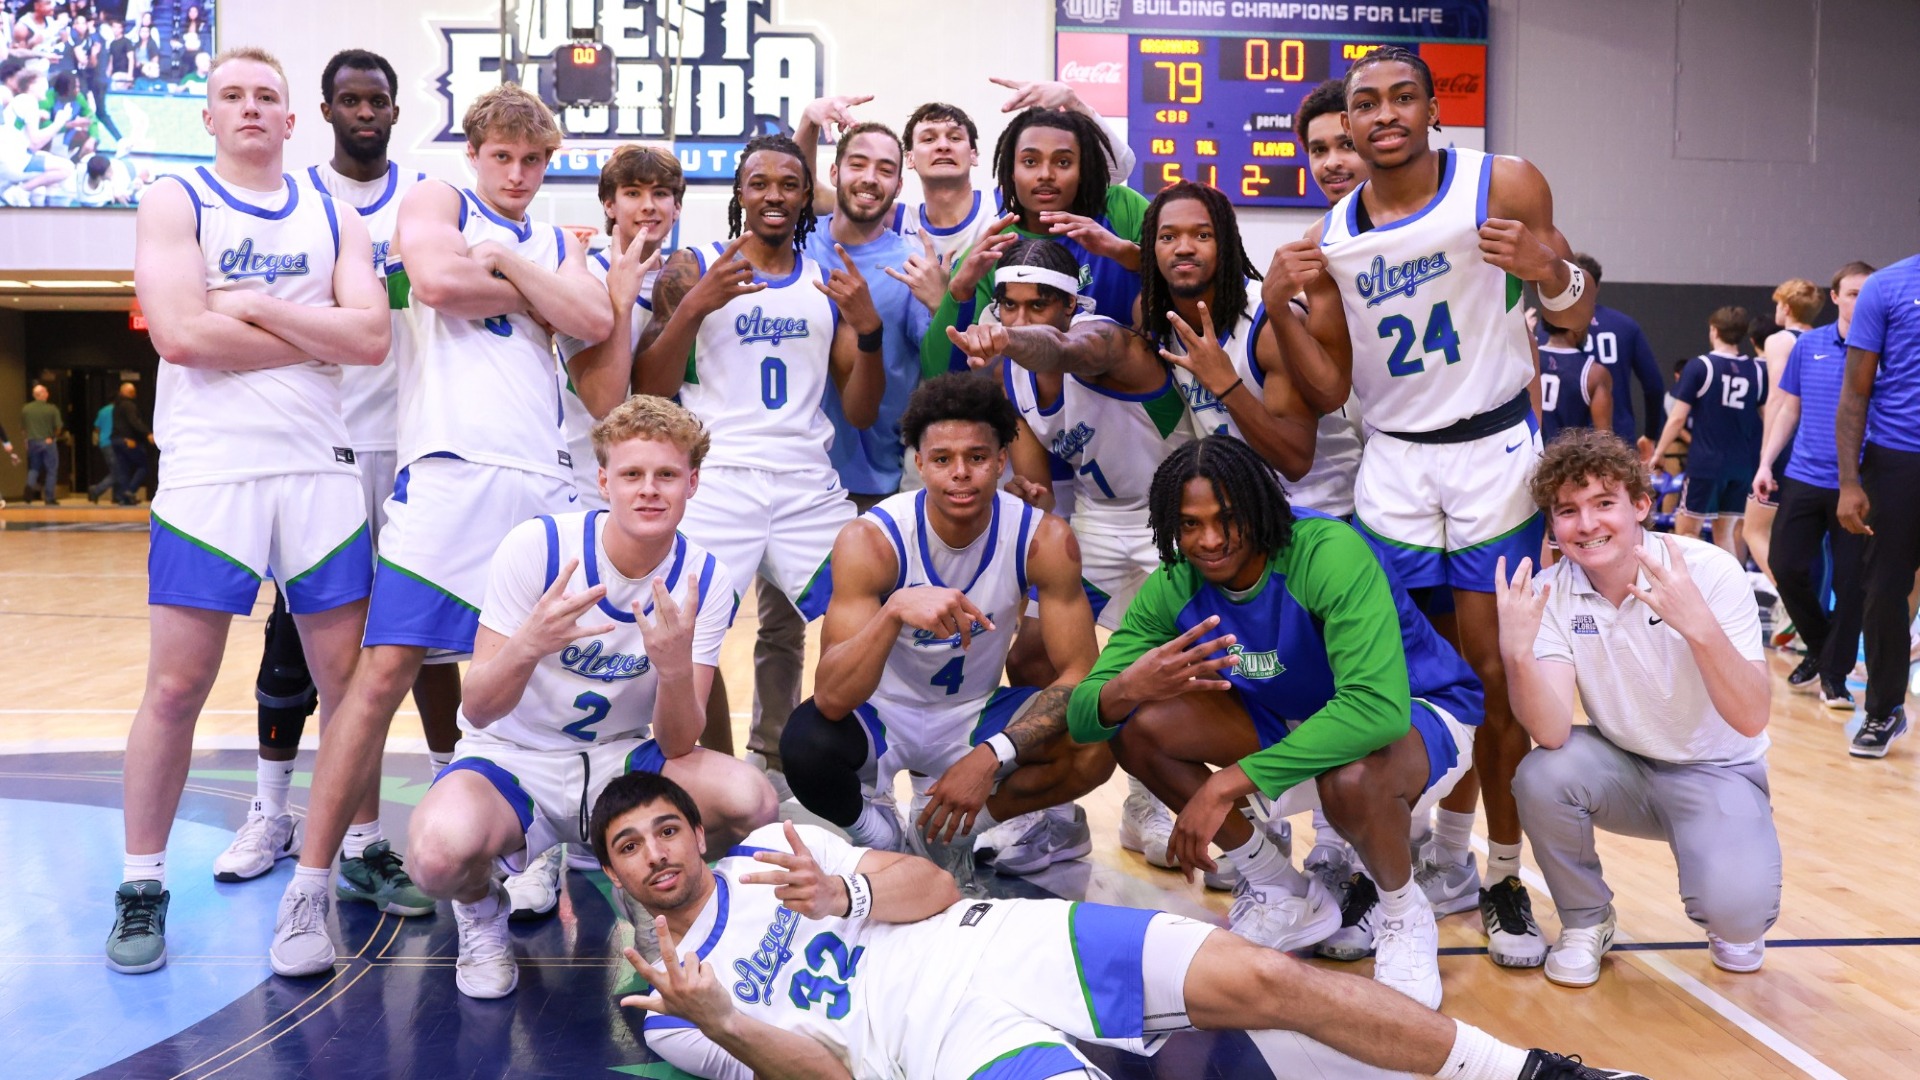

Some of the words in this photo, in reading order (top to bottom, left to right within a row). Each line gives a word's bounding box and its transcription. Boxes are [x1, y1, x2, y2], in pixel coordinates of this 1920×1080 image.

[515, 0, 764, 59] WEST
[1132, 0, 1226, 17] BUILDING
[1231, 3, 1349, 21] CHAMPIONS
[1354, 6, 1394, 23] FOR
[1399, 8, 1443, 24] LIFE
[1245, 38, 1305, 82] 0.0
[1154, 61, 1203, 105] 79
[1255, 113, 1293, 130] period
[1151, 139, 1175, 155] FLS
[1252, 141, 1296, 157] PLAYER
[218, 237, 310, 285] Argos
[1355, 251, 1453, 309] Argos
[735, 305, 810, 347] Argos
[1377, 299, 1461, 377] 24
[760, 356, 788, 410] 0
[1721, 373, 1750, 410] 12
[560, 639, 651, 683] Argos
[930, 654, 966, 696] 4
[561, 690, 612, 742] 2
[733, 903, 802, 1006] Argos
[788, 931, 866, 1021] 32
